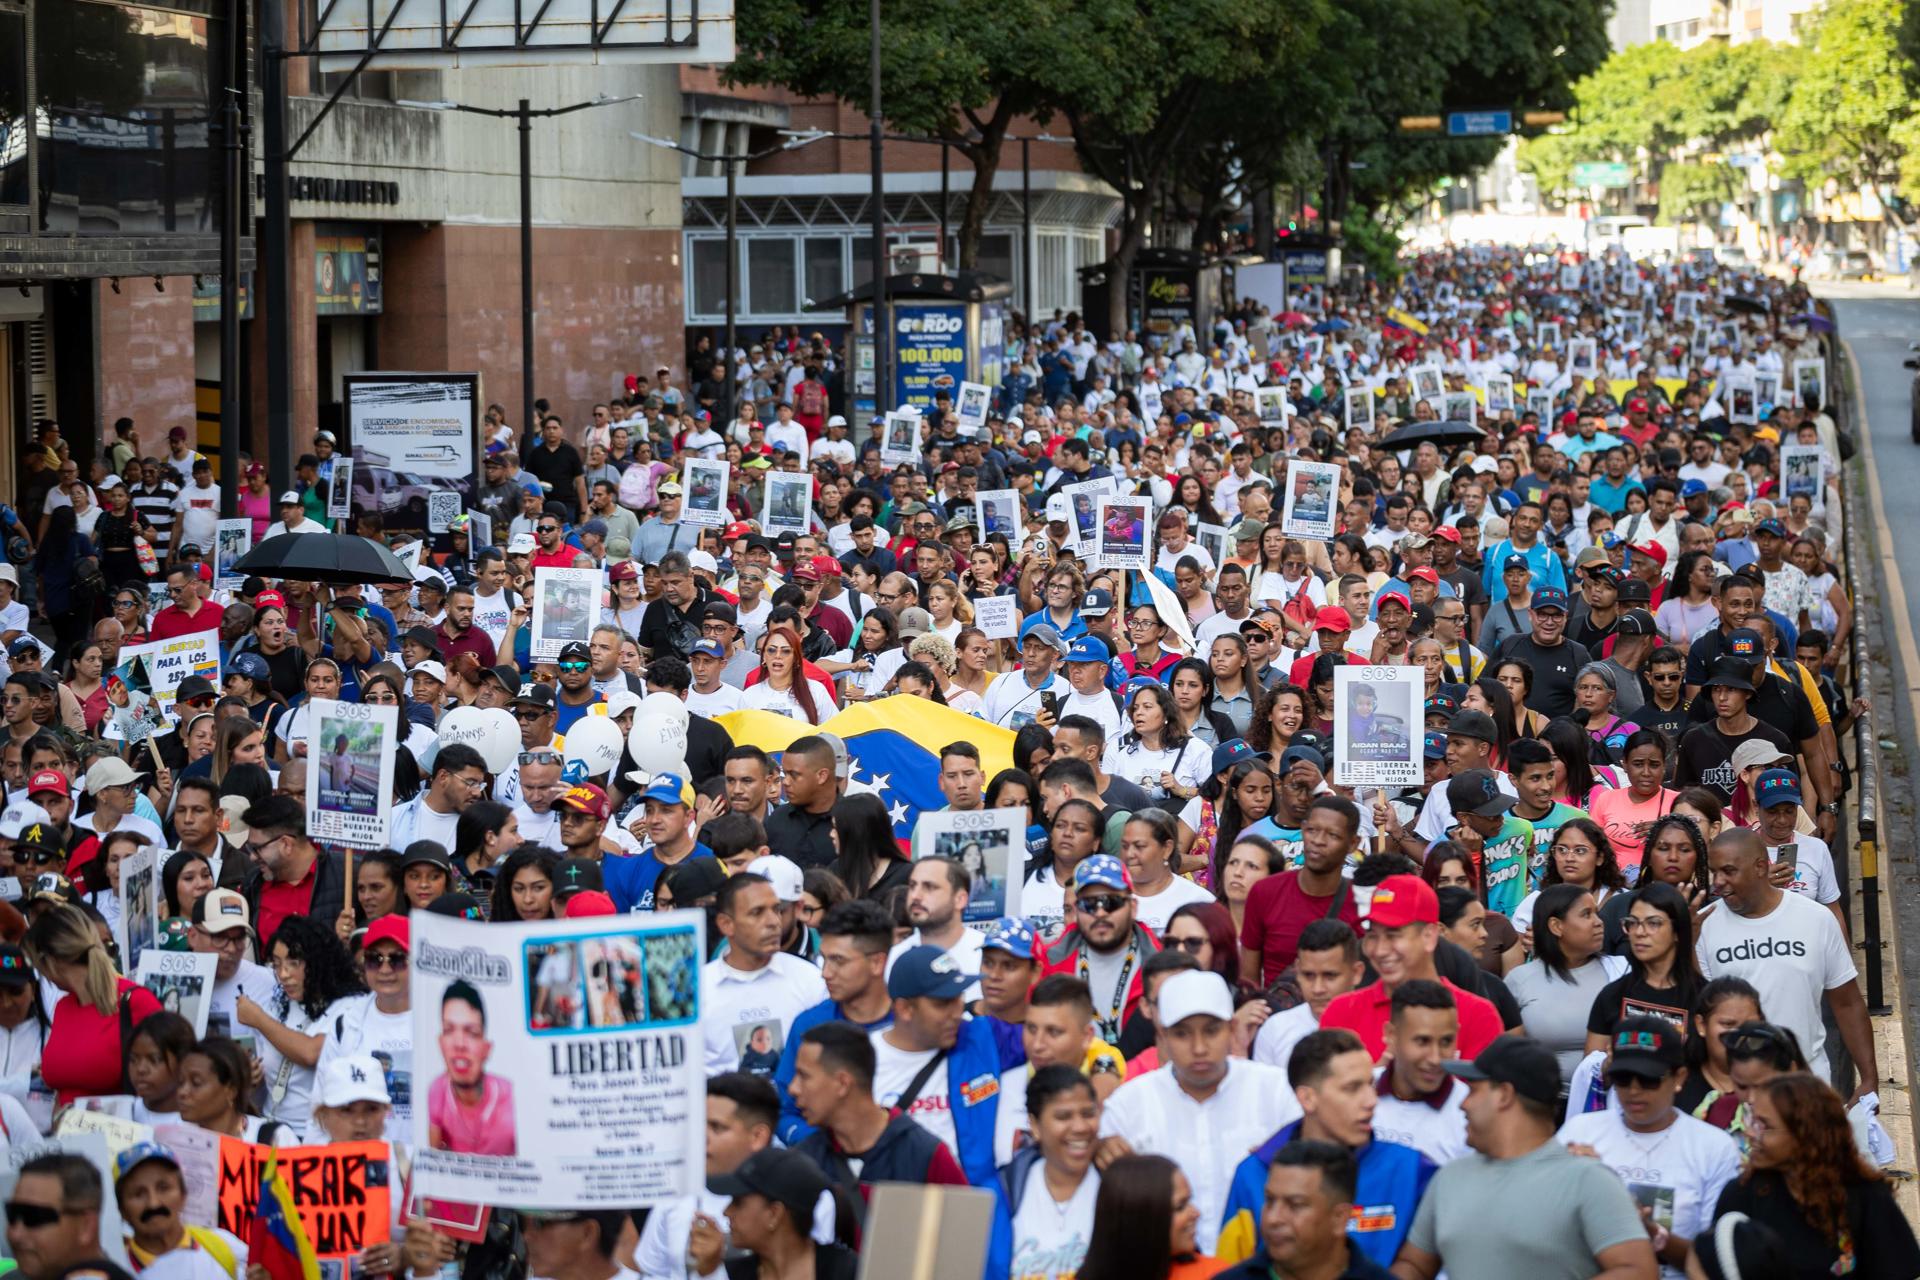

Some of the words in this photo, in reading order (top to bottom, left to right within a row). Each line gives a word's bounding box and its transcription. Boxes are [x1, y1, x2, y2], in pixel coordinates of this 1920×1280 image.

[899, 348, 963, 363] 100.000
[1112, 496, 1137, 505] SOS
[555, 568, 583, 580] SOS
[162, 639, 205, 654] LIBERTAD
[1735, 643, 1750, 651] CCS
[156, 656, 182, 669] PARA
[188, 652, 207, 664] LOS
[1361, 667, 1397, 680] SOS
[335, 702, 372, 720] SOS
[1657, 722, 1678, 731] FOX
[1702, 769, 1728, 784] JUST
[504, 768, 519, 801] VZLA
[343, 815, 376, 824] LIBEREN
[953, 812, 995, 830] SOS
[343, 823, 383, 833] NUESTROS
[1716, 937, 1806, 964] adidas
[160, 953, 197, 973] SOS
[739, 1006, 771, 1022] SOS
[551, 1034, 686, 1076] LIBERTAD
[571, 1079, 598, 1089] Para
